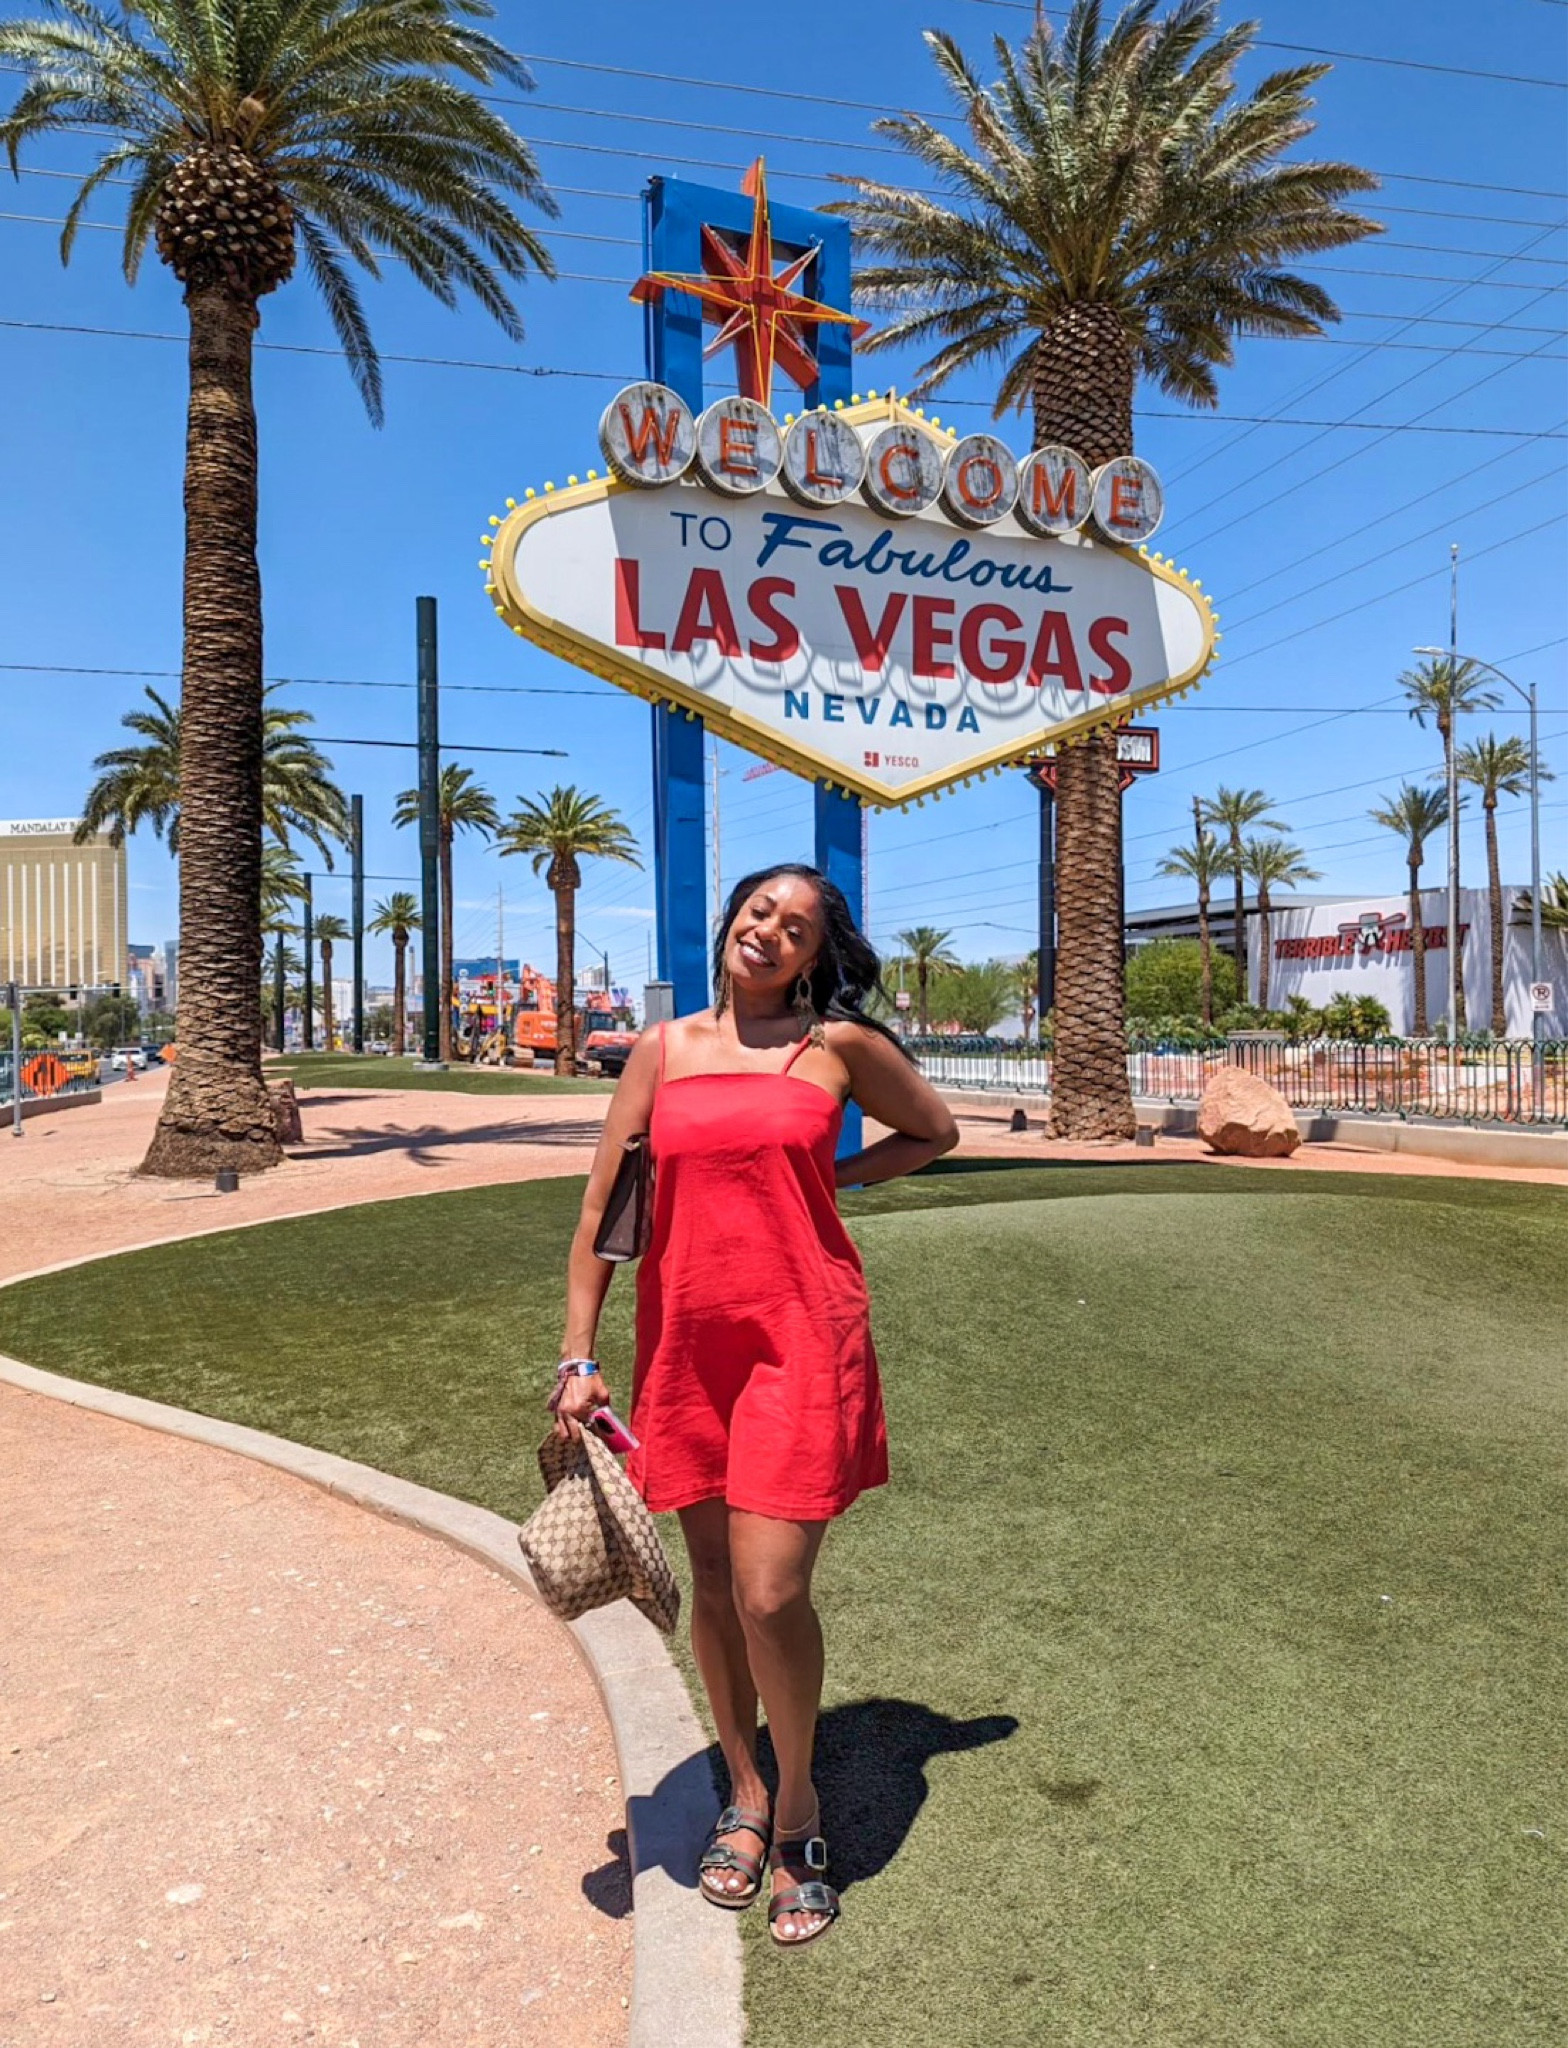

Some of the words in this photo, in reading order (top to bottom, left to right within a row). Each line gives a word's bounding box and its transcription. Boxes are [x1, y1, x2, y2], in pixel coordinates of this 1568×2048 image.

[618, 403, 1141, 527] WELCOME
[670, 511, 731, 550] TO
[756, 513, 1073, 593] Fabulous
[615, 557, 800, 662] LAS
[834, 585, 1132, 694] VEGAS
[784, 690, 981, 734] NEVADA
[885, 755, 919, 767] YESCO
[10, 821, 67, 834] MANDALAY
[1275, 932, 1356, 960] TERRIBLE
